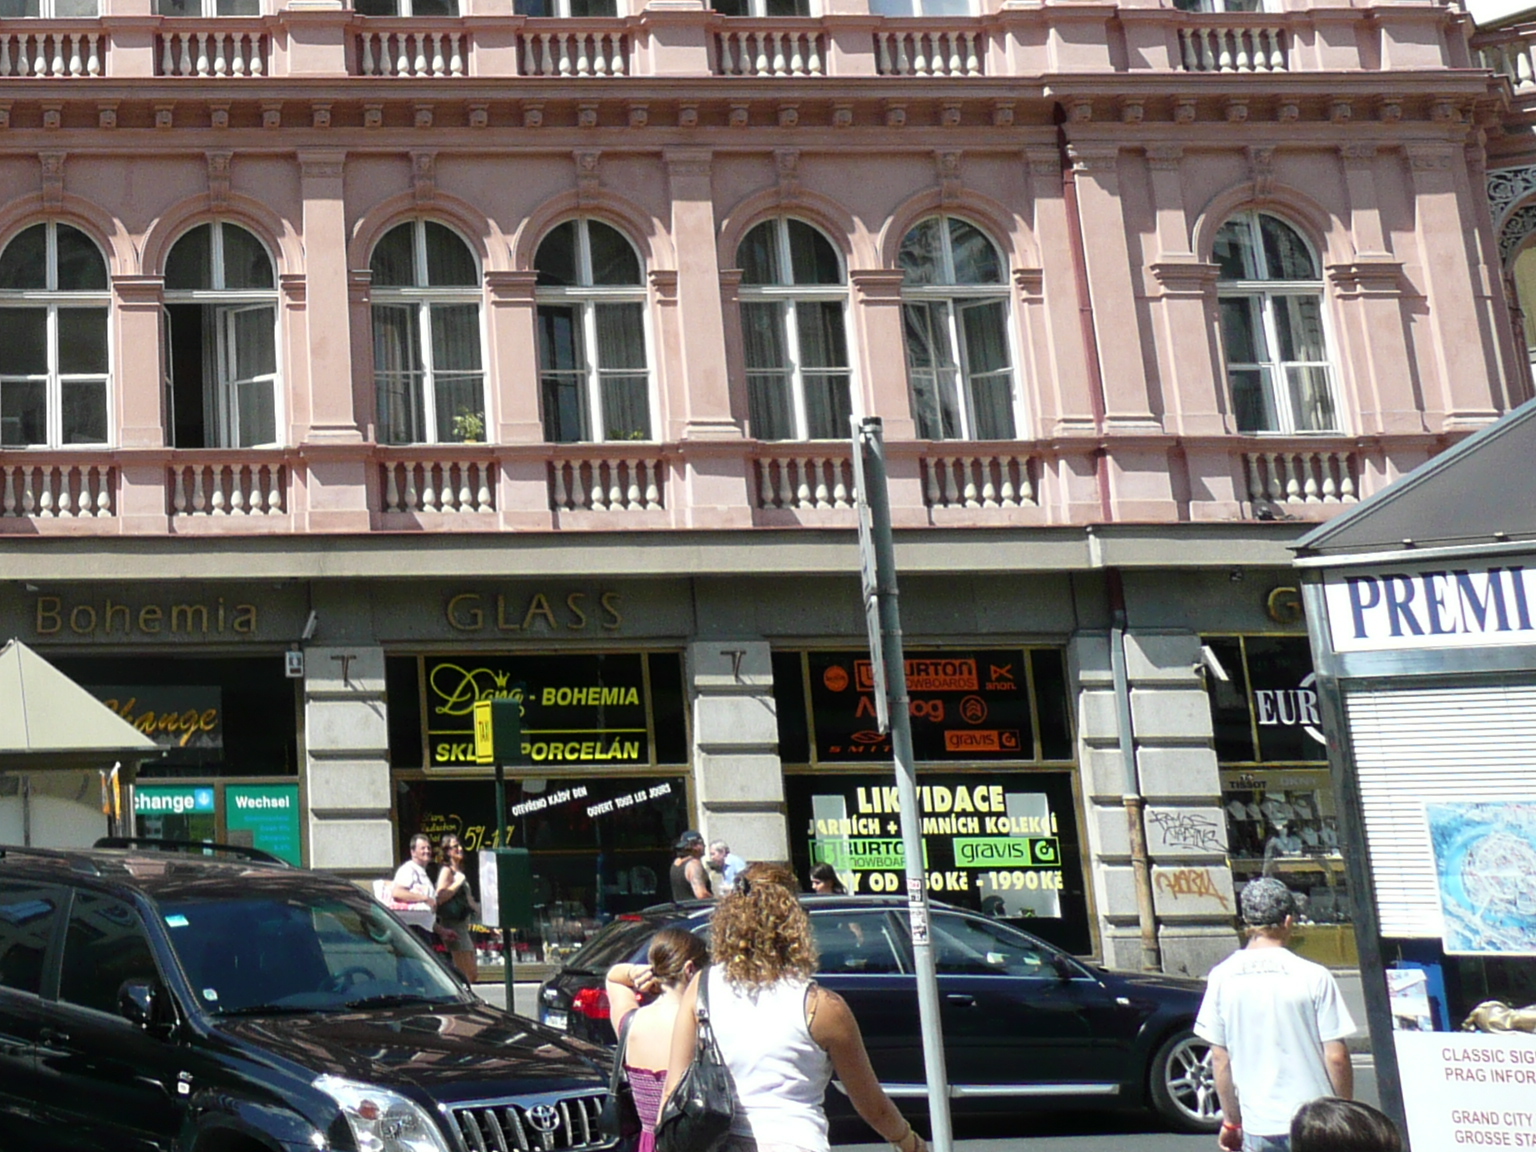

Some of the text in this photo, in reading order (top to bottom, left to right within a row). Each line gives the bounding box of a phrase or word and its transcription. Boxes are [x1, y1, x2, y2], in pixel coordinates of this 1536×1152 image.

[447, 592, 624, 630] GLASS
[1344, 566, 1535, 638] PREMI
[36, 596, 258, 635] Bohemia
[541, 687, 640, 706] BOHEMIA
[949, 732, 995, 748] gravis
[435, 737, 640, 762] SKL PORCELÁN
[828, 745, 893, 754] SMIT
[1229, 781, 1267, 790] TISSOT
[235, 795, 290, 809] Wechsel
[961, 842, 1024, 863] gravis
[868, 872, 899, 892] OD
[1442, 1047, 1536, 1065] CLASSIC SIG
[1444, 1067, 1487, 1083] PRAG
[1451, 1110, 1533, 1127] GRAND CITY
[1454, 1130, 1512, 1147] GROSSE
